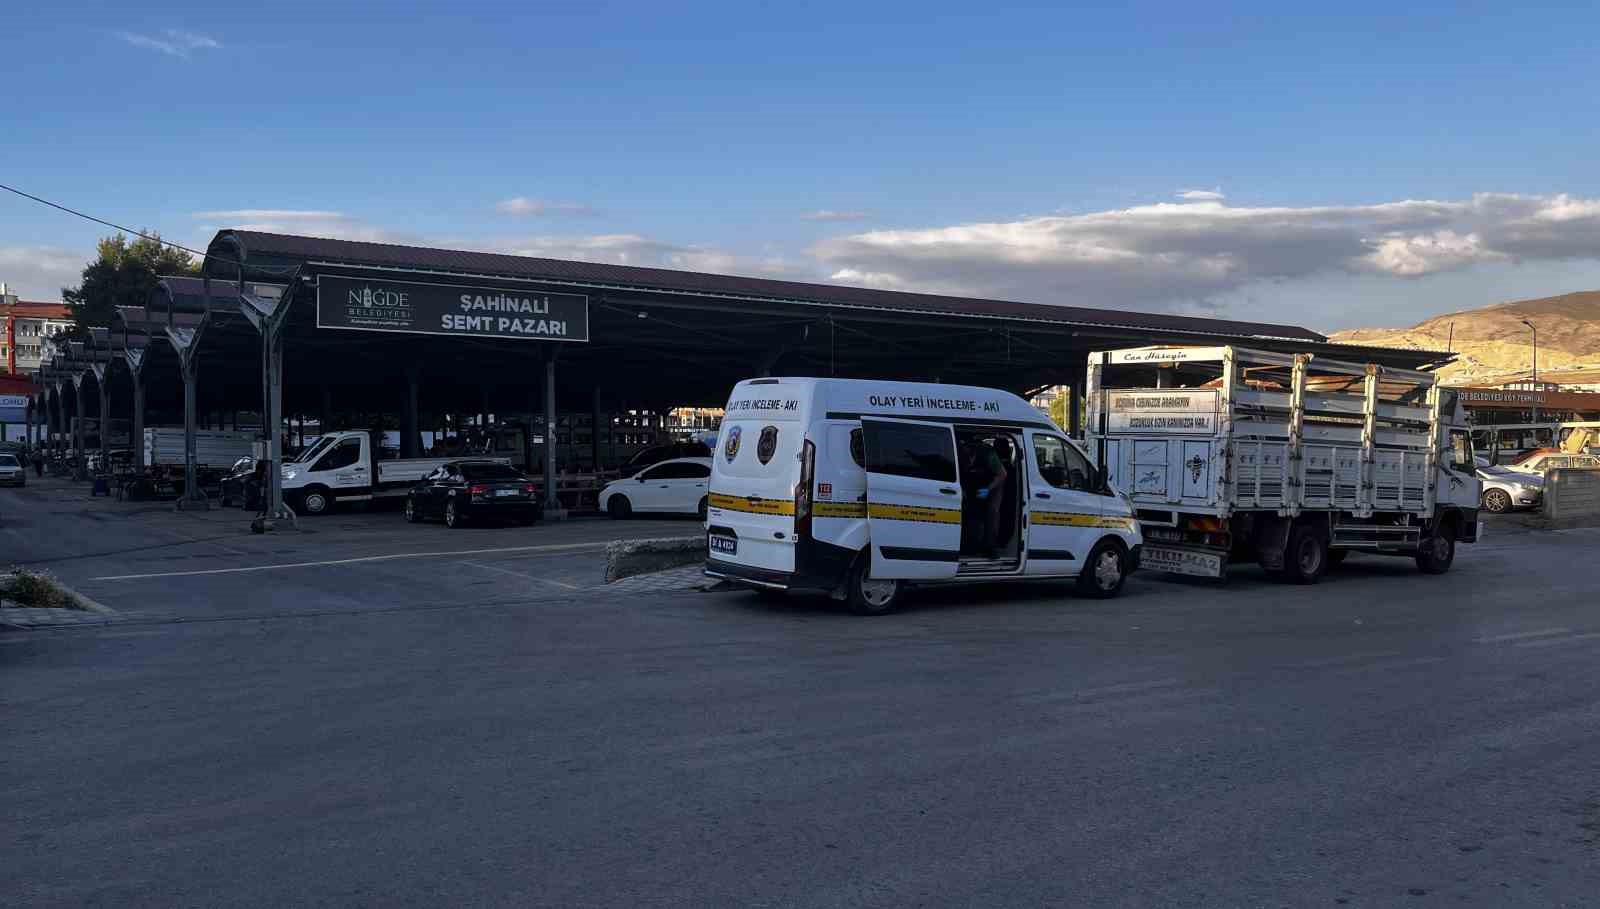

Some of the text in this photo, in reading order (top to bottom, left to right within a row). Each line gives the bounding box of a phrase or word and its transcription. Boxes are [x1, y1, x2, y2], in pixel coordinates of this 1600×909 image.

[460, 293, 549, 314] ŞAHİNALİ
[441, 314, 567, 336] SEMT PAZARI
[1123, 351, 1187, 362] Can Hüseyin
[870, 395, 897, 407] OLAY
[901, 394, 924, 408] YERİ
[927, 395, 976, 411] İNCELEME
